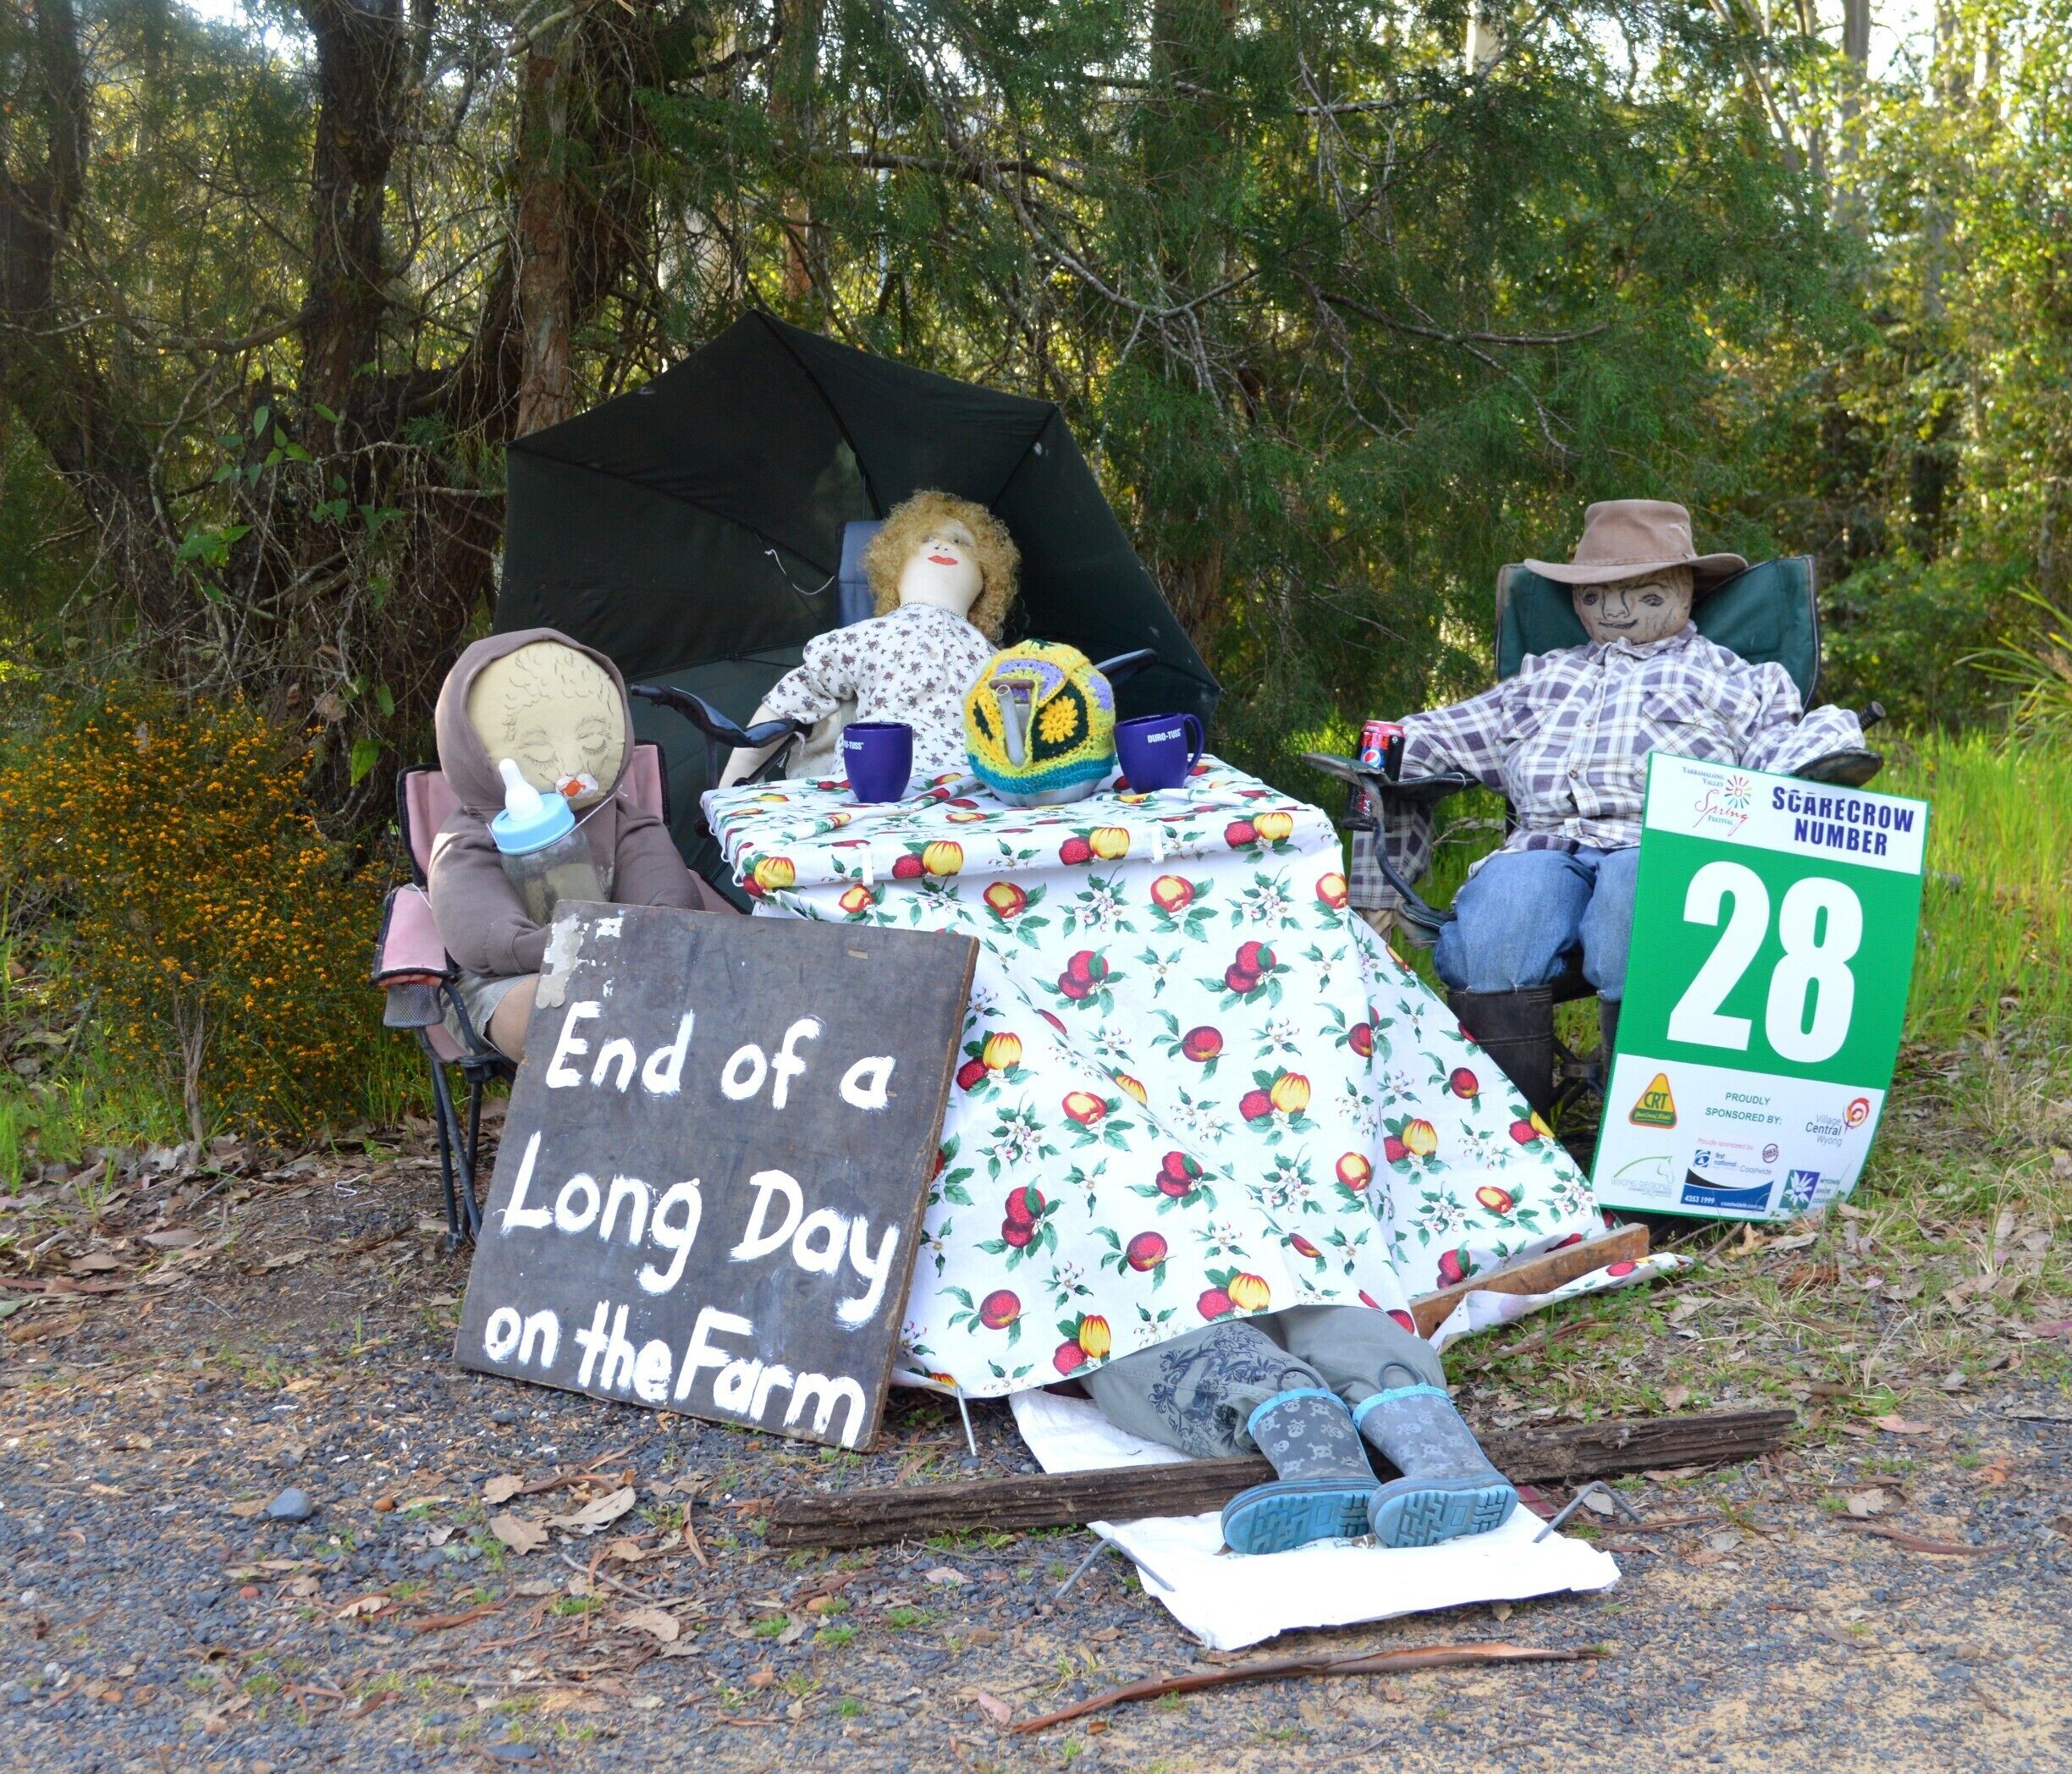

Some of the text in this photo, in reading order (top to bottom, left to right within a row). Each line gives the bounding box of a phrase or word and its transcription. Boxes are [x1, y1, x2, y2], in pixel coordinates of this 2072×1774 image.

[1147, 728, 1182, 743] DURO-TUSS
[1683, 766, 1725, 780] YARRAMALONG
[1703, 778, 1724, 788] VALLEY
[1692, 789, 1750, 837] Spring
[1772, 786, 1915, 833] SCARECROW
[1708, 814, 1733, 826] FESTIVAL
[1794, 818, 1888, 857] NUMBER
[1667, 861, 1863, 1064] 28
[546, 1001, 897, 1111] End of a
[1644, 1091, 1668, 1110] CRT
[1725, 1092, 1771, 1105] PROUDLY
[1705, 1107, 1782, 1125] SPONSORED BY:
[1816, 1114, 1841, 1127] Village
[1805, 1121, 1843, 1136] Central
[1816, 1135, 1843, 1148] Wyong
[1684, 1194, 1716, 1204] 4353 1999
[499, 1132, 901, 1331] Long Day
[482, 1300, 866, 1448] on the Farm
